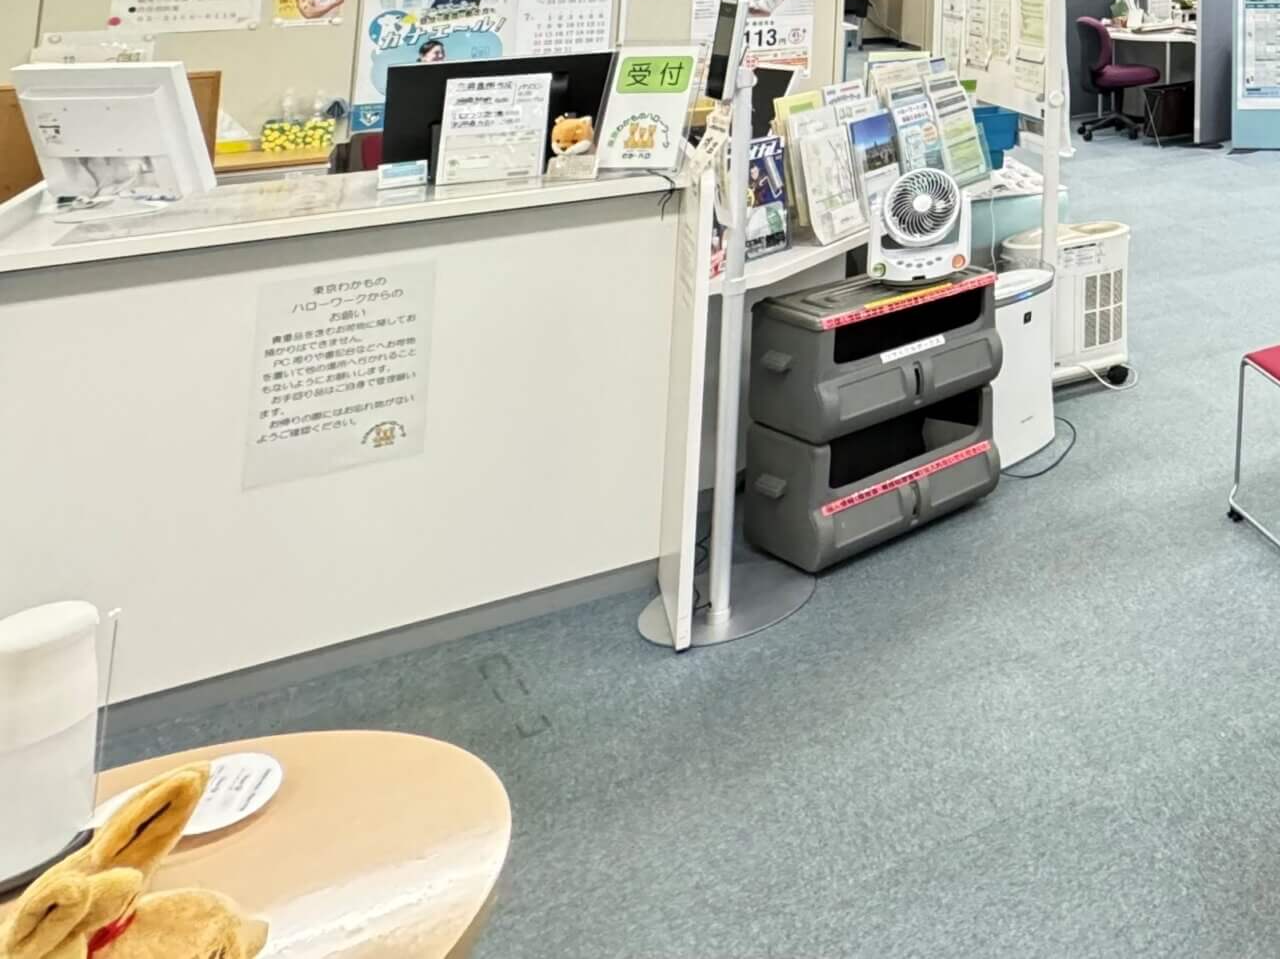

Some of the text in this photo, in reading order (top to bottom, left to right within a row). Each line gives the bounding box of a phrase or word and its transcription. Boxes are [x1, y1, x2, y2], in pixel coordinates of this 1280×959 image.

[626, 62, 684, 86] 受付
[313, 277, 387, 295] 東京わかもの
[291, 289, 404, 314] ハローワークからの
